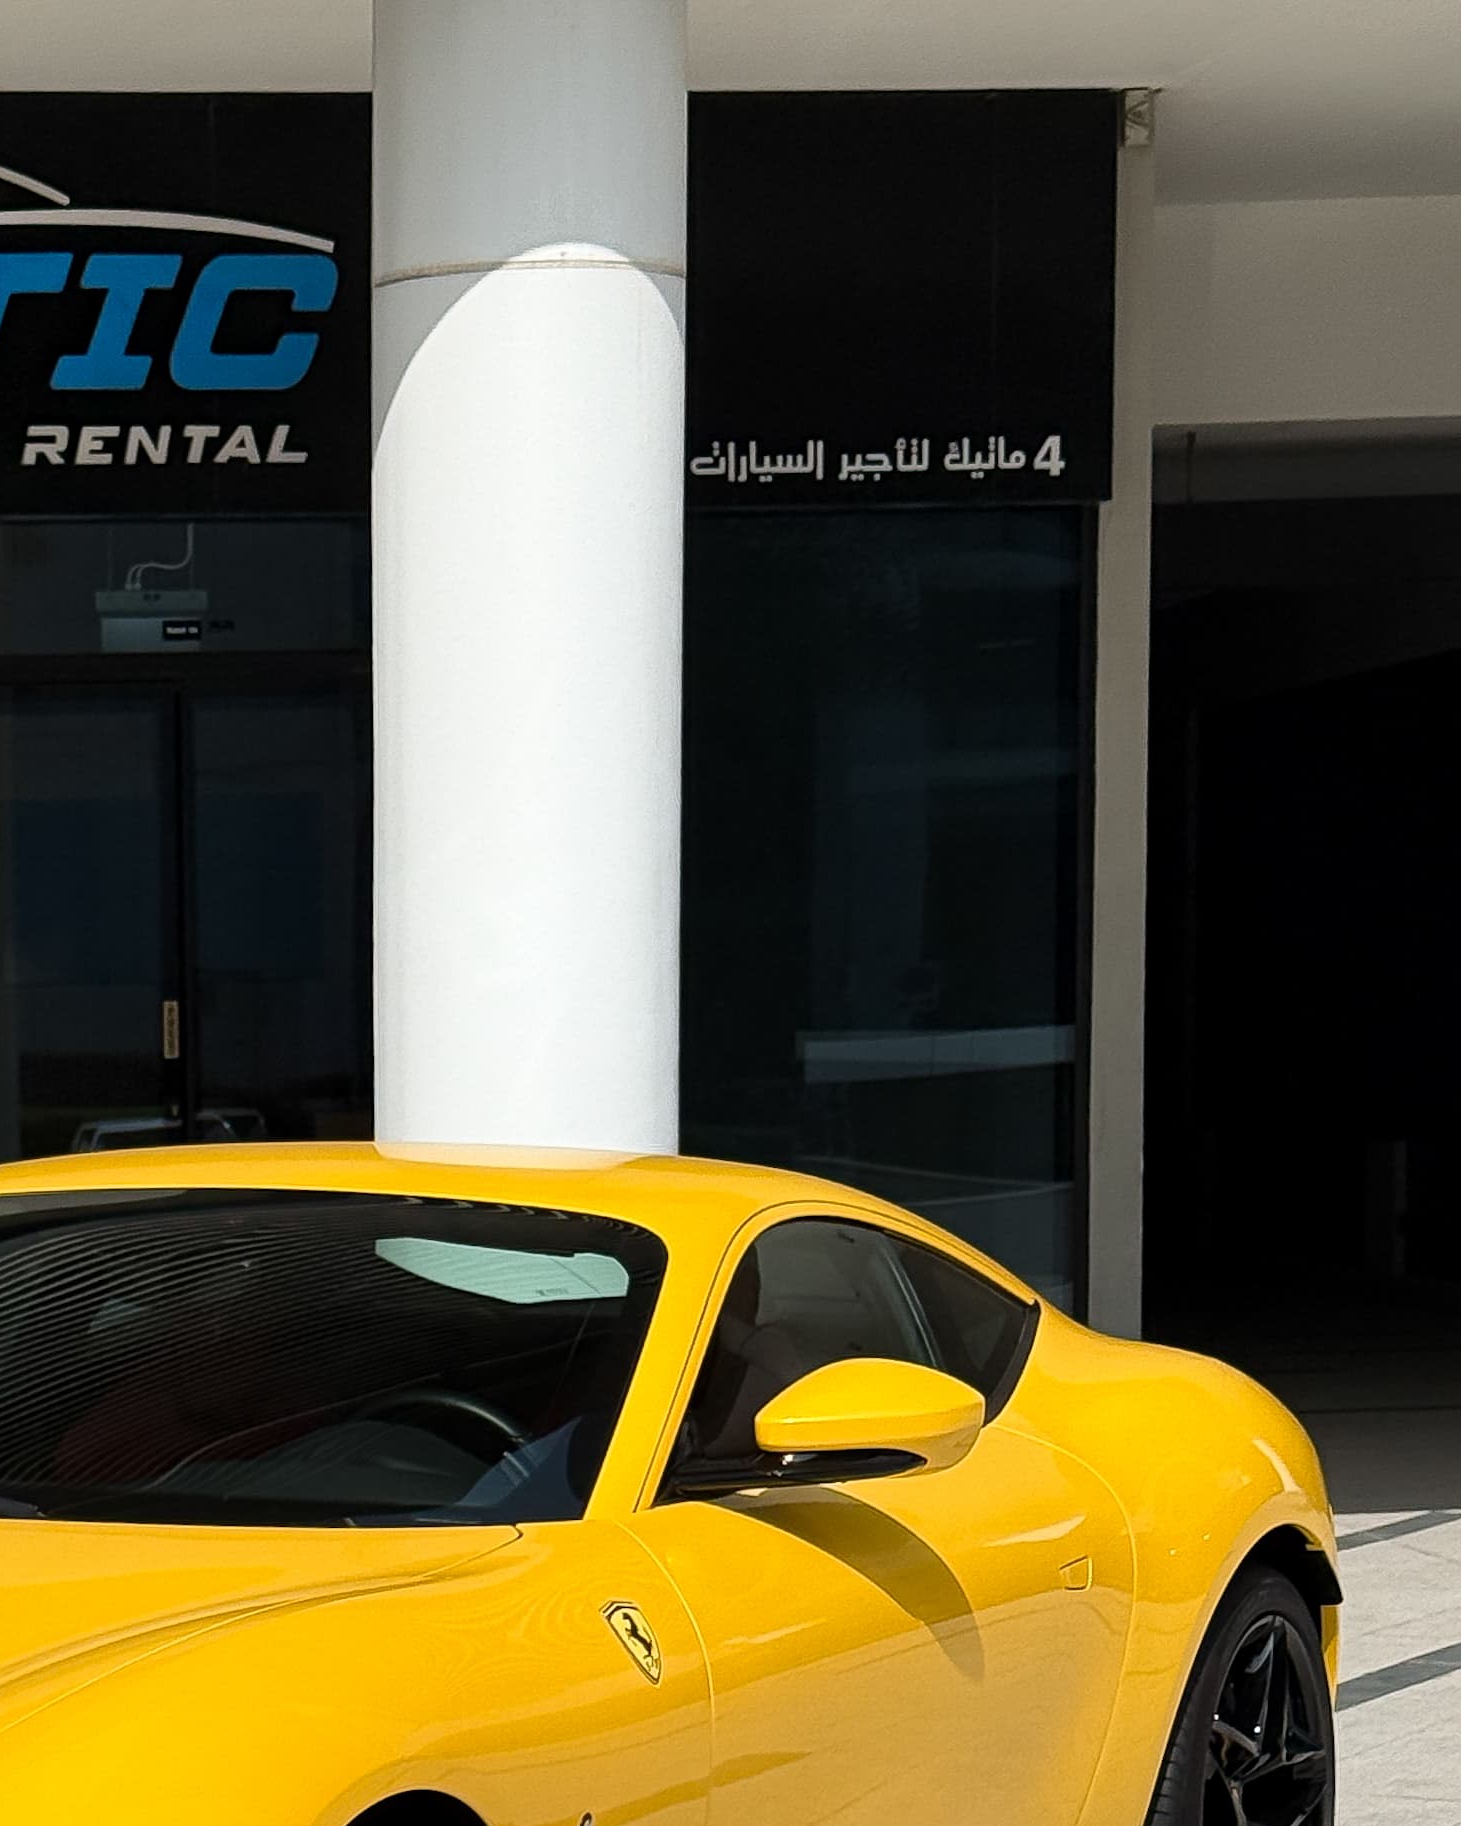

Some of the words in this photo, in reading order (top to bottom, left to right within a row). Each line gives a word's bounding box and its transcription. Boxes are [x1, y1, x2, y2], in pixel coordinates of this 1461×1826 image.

[21, 424, 309, 465] RENTAL
[690, 440, 824, 483] السيارات
[838, 437, 930, 482] لتأجير
